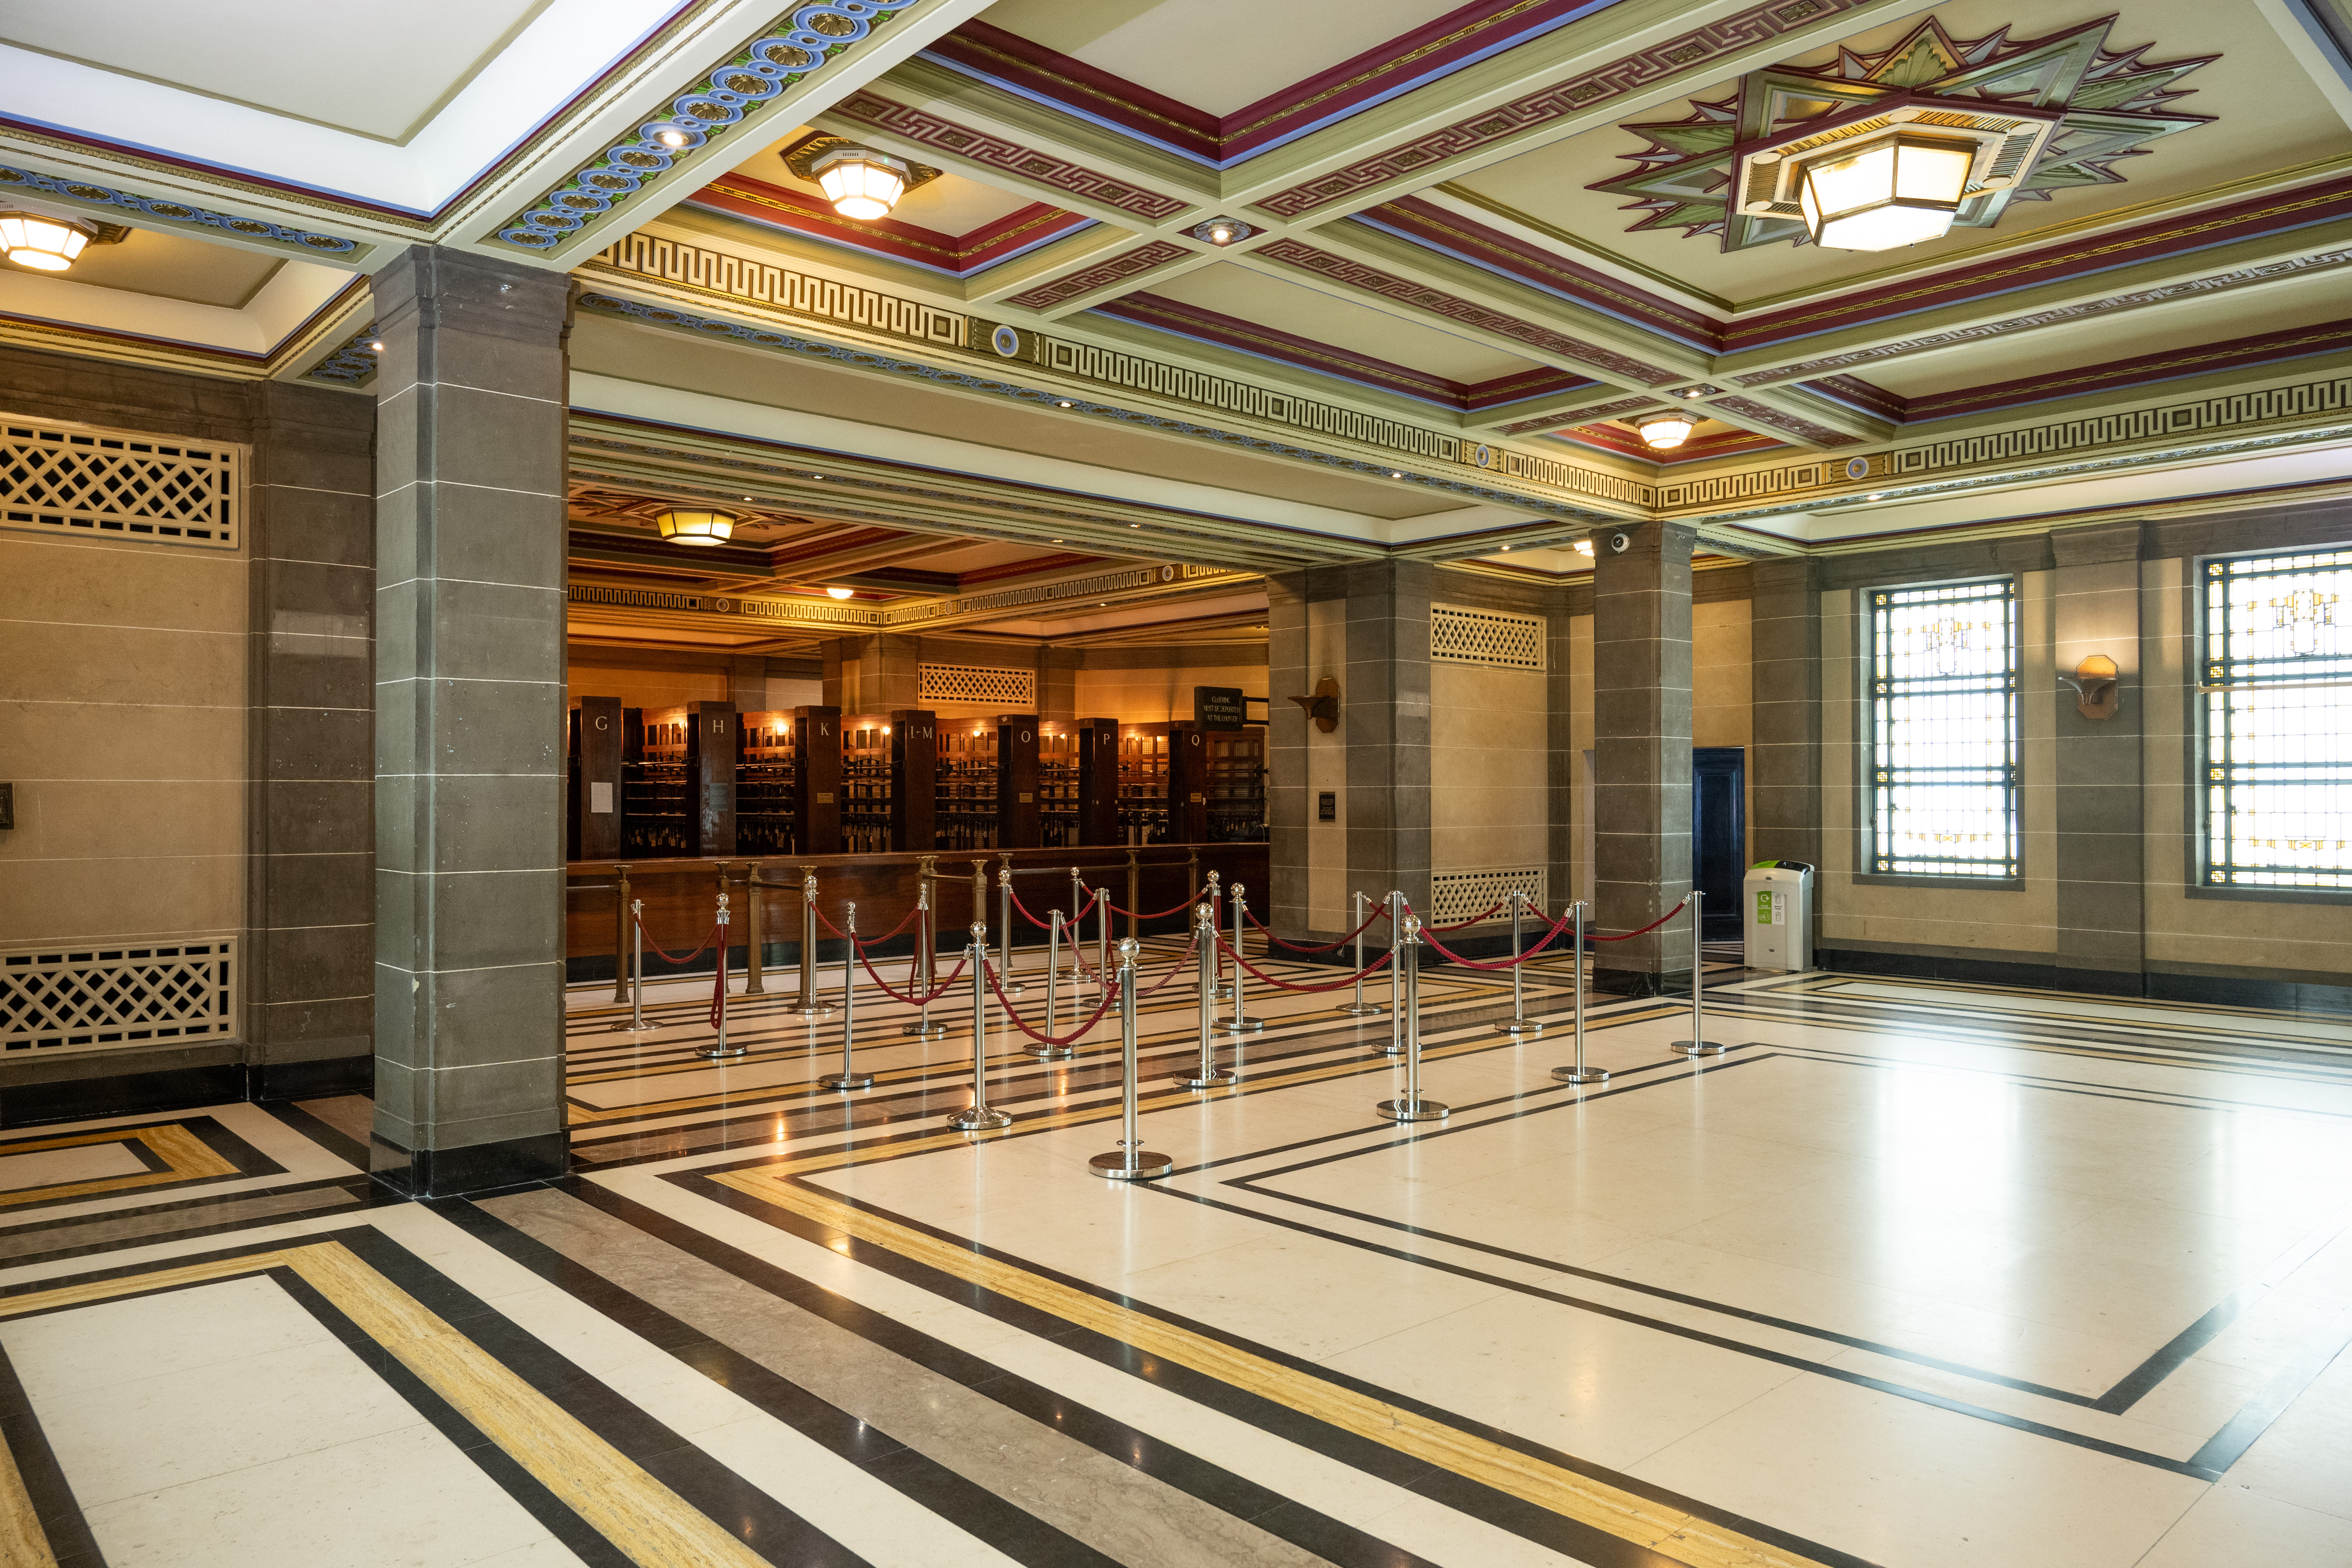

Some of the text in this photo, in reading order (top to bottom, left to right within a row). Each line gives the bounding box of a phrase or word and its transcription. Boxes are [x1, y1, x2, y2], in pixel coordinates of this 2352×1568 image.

[595, 716, 607, 730] G
[713, 720, 723, 733] H
[821, 723, 829, 735] K
[1021, 731, 1031, 742] O
[1104, 733, 1110, 744] P
[1192, 735, 1199, 746] Q
